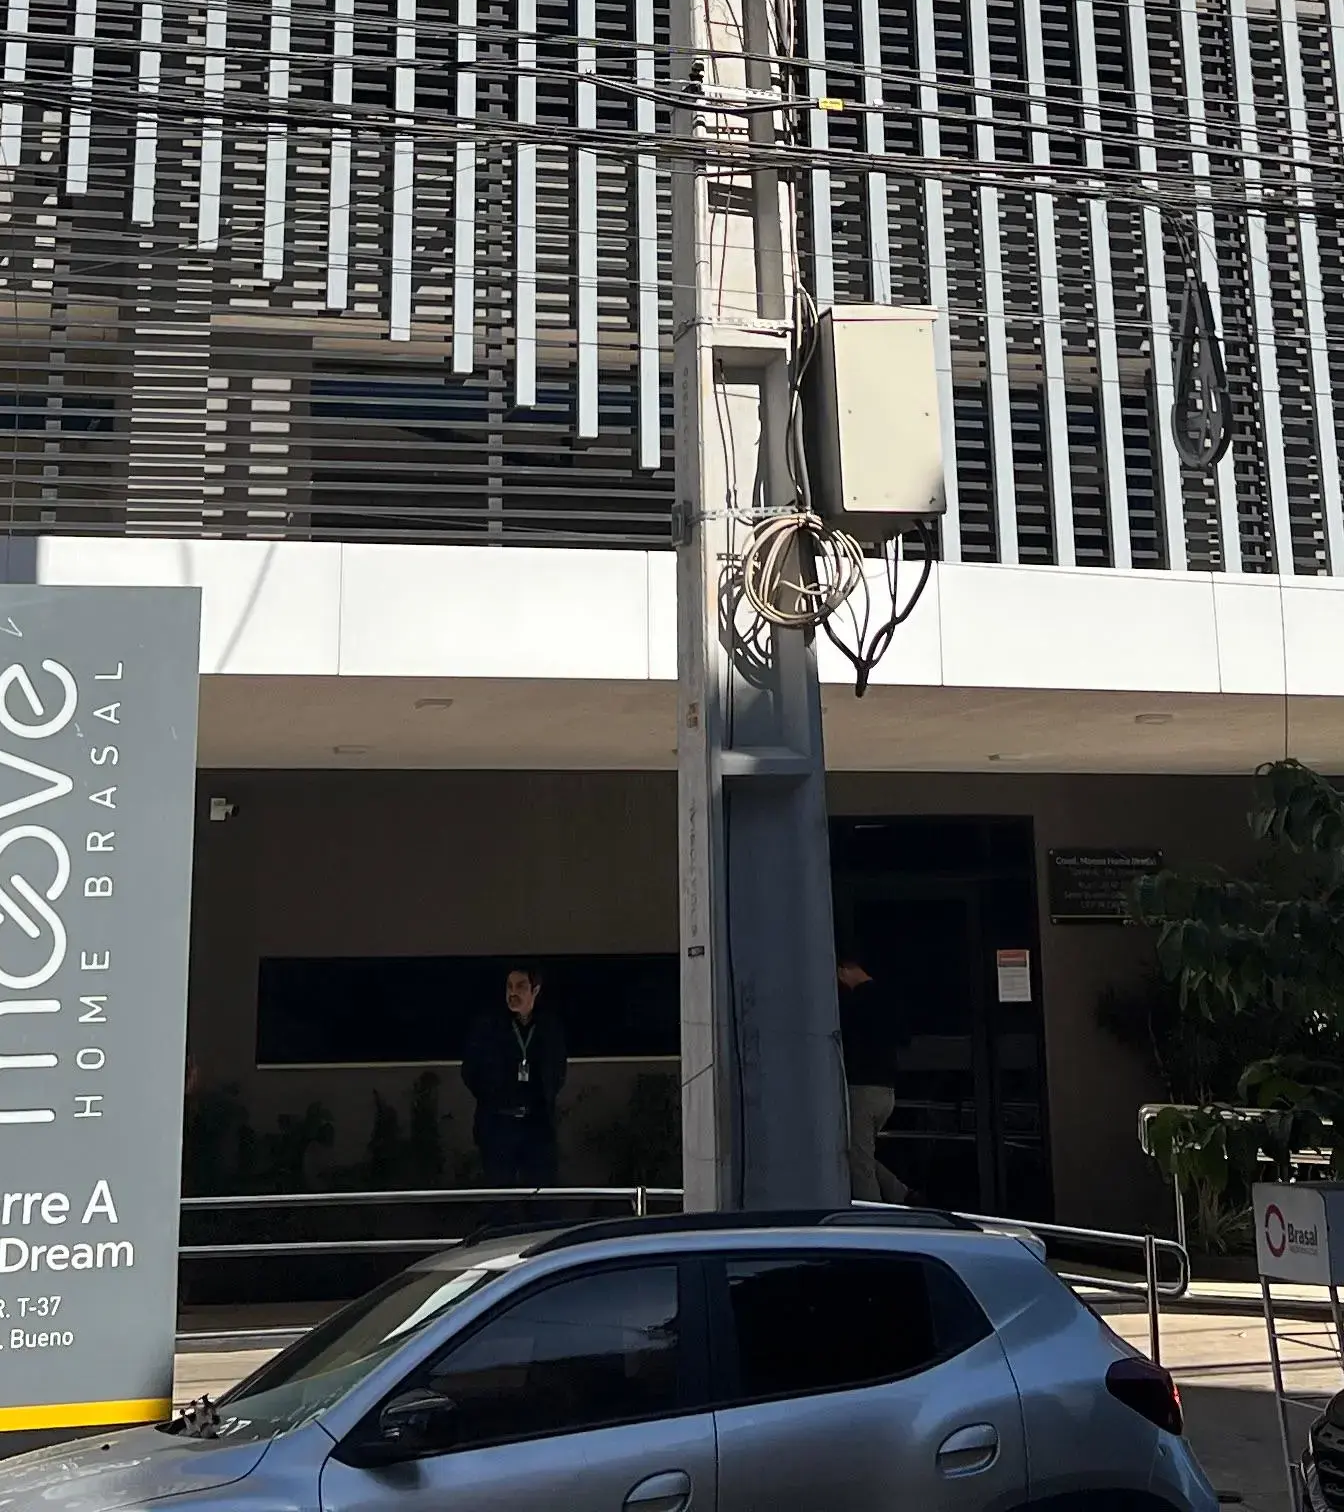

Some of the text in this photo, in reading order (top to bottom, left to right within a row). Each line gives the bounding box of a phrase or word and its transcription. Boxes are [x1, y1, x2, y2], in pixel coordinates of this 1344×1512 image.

[73, 661, 123, 1118] HOME BRASAL
[81, 1179, 119, 1224] A
[1287, 1223, 1318, 1246] Brasal
[17, 1296, 62, 1318] T-37
[10, 1329, 74, 1349] Bueno
